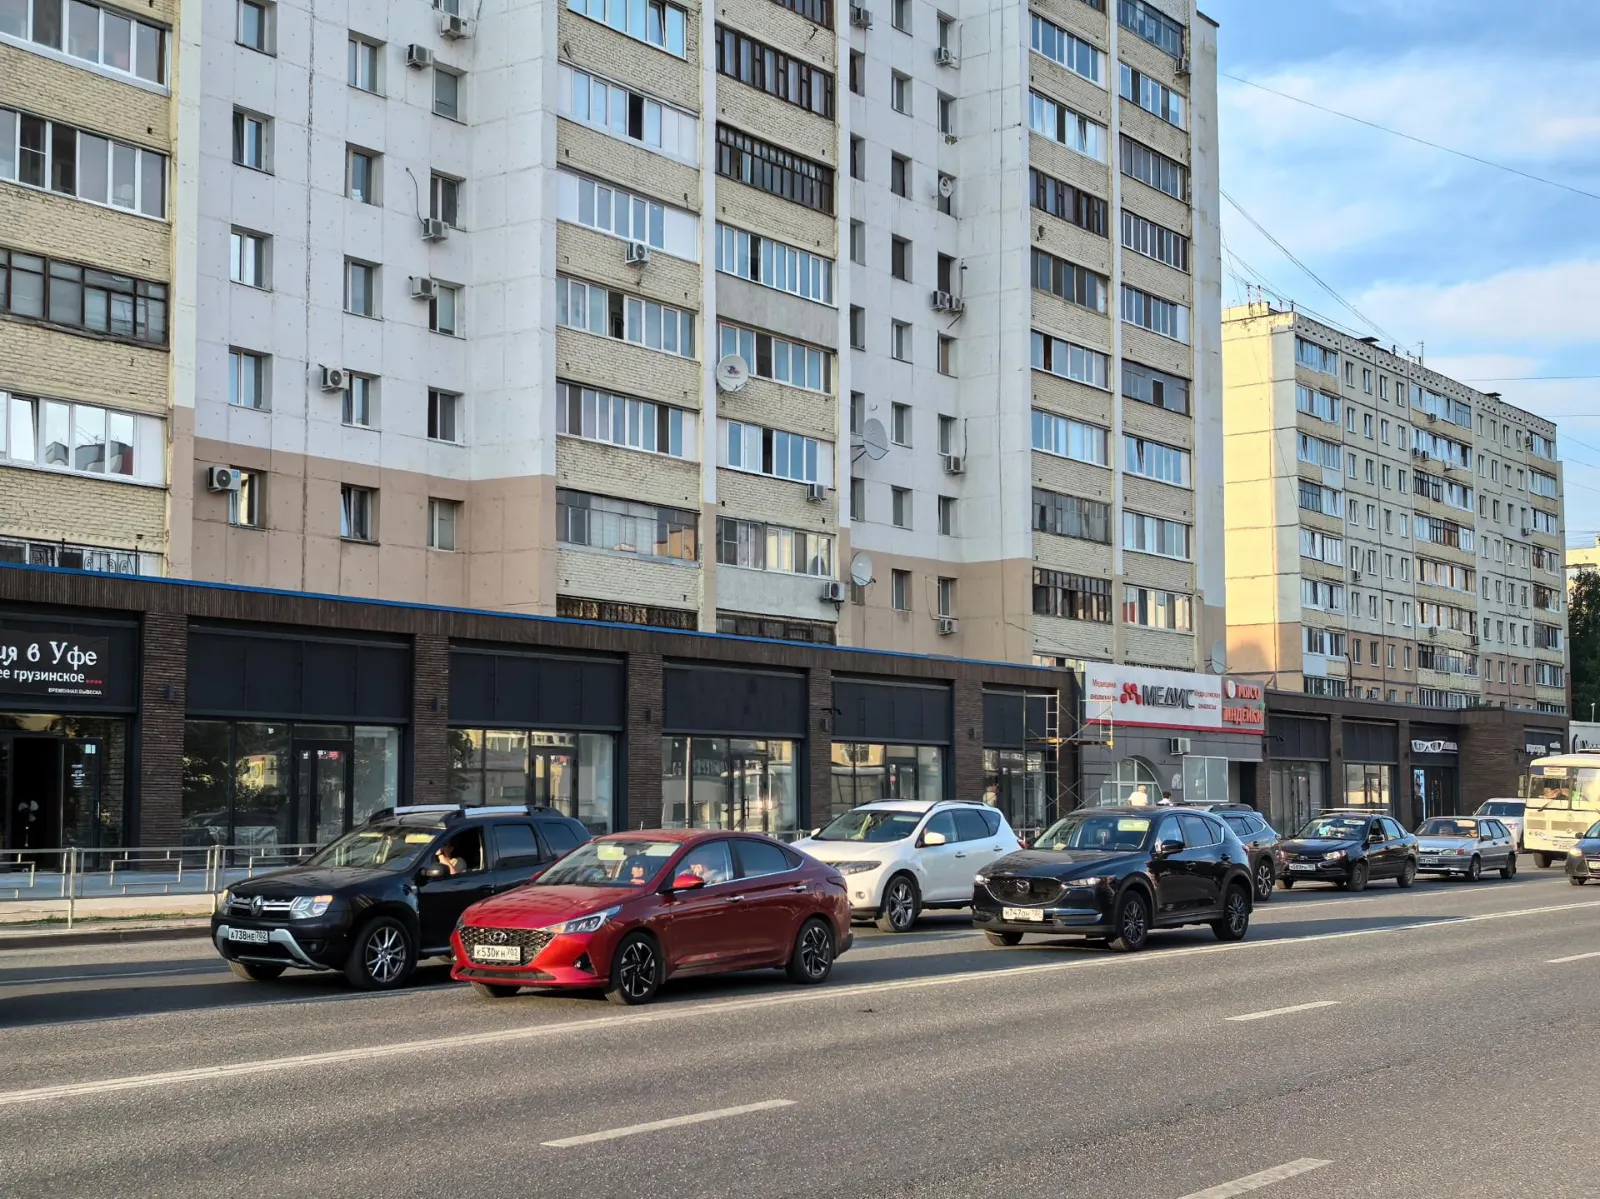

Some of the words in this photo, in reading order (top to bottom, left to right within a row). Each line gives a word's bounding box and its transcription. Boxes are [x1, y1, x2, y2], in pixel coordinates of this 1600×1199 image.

[27, 643, 40, 662] в
[49, 641, 98, 671] Уфе
[14, 669, 85, 683] грузинское
[1142, 684, 1195, 710] МЕДИС
